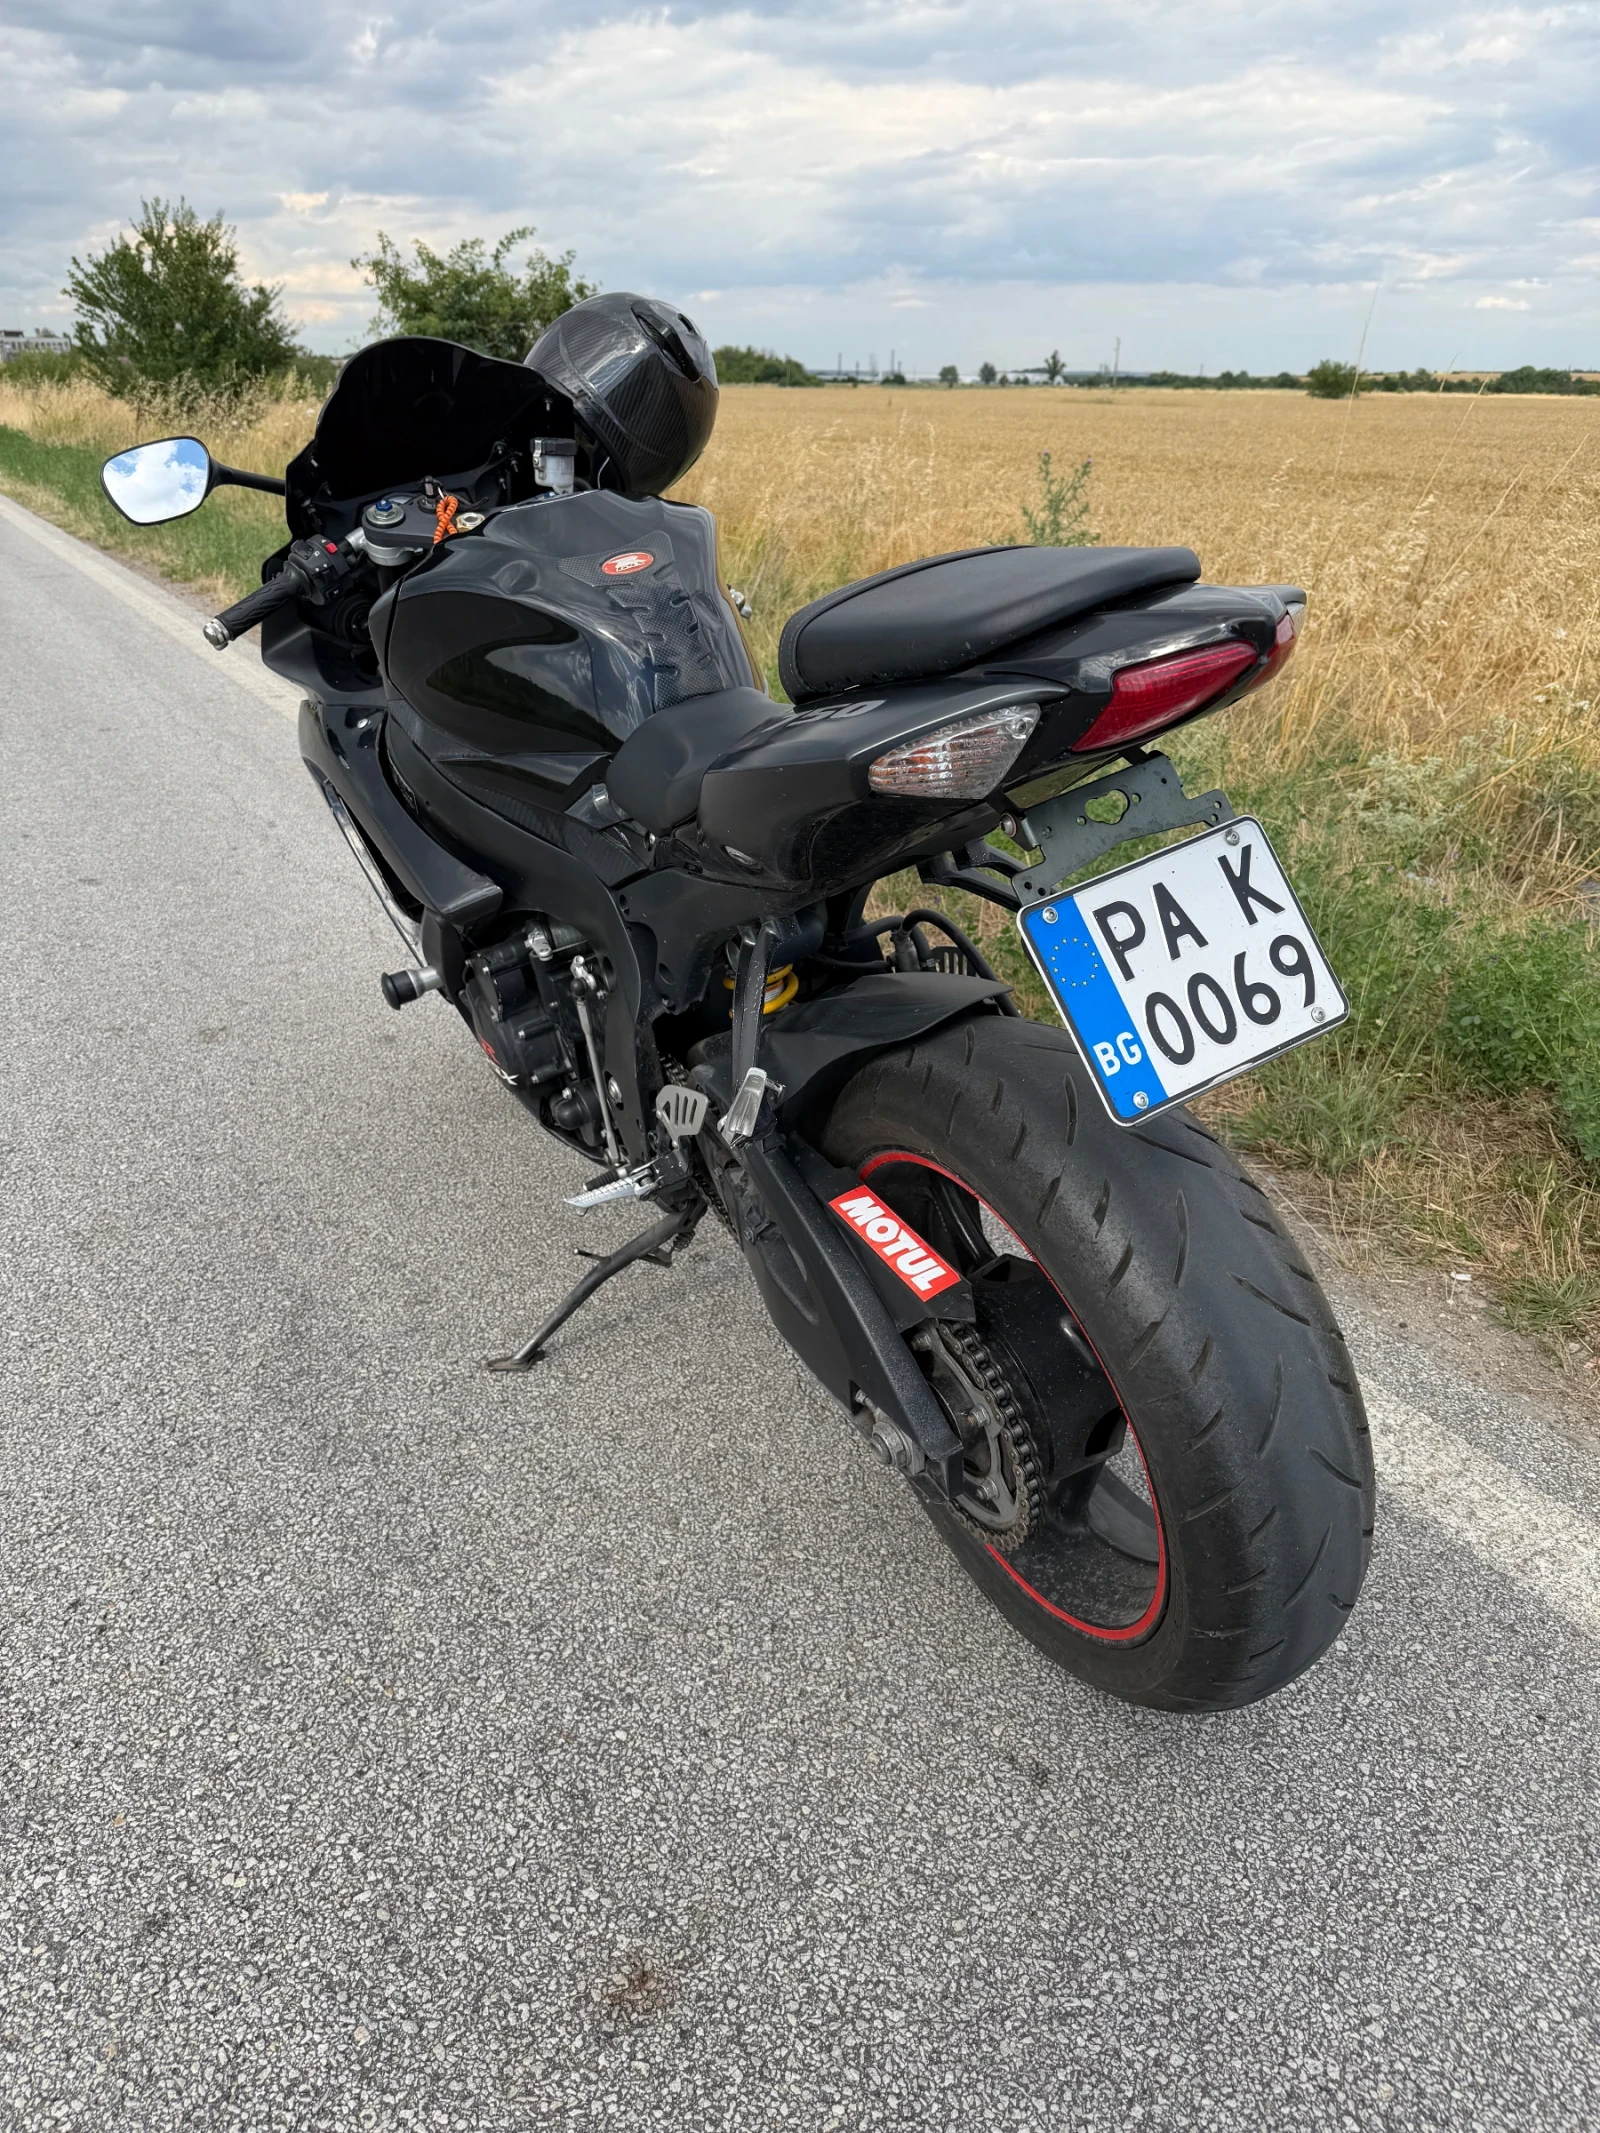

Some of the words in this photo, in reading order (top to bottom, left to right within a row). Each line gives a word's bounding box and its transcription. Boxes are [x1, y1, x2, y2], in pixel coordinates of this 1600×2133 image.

[1092, 882, 1209, 982] PA
[1217, 844, 1286, 926] K
[1092, 1031, 1143, 1077] BG
[1144, 934, 1316, 1066] 0069
[838, 1195, 947, 1291] MOTUL
